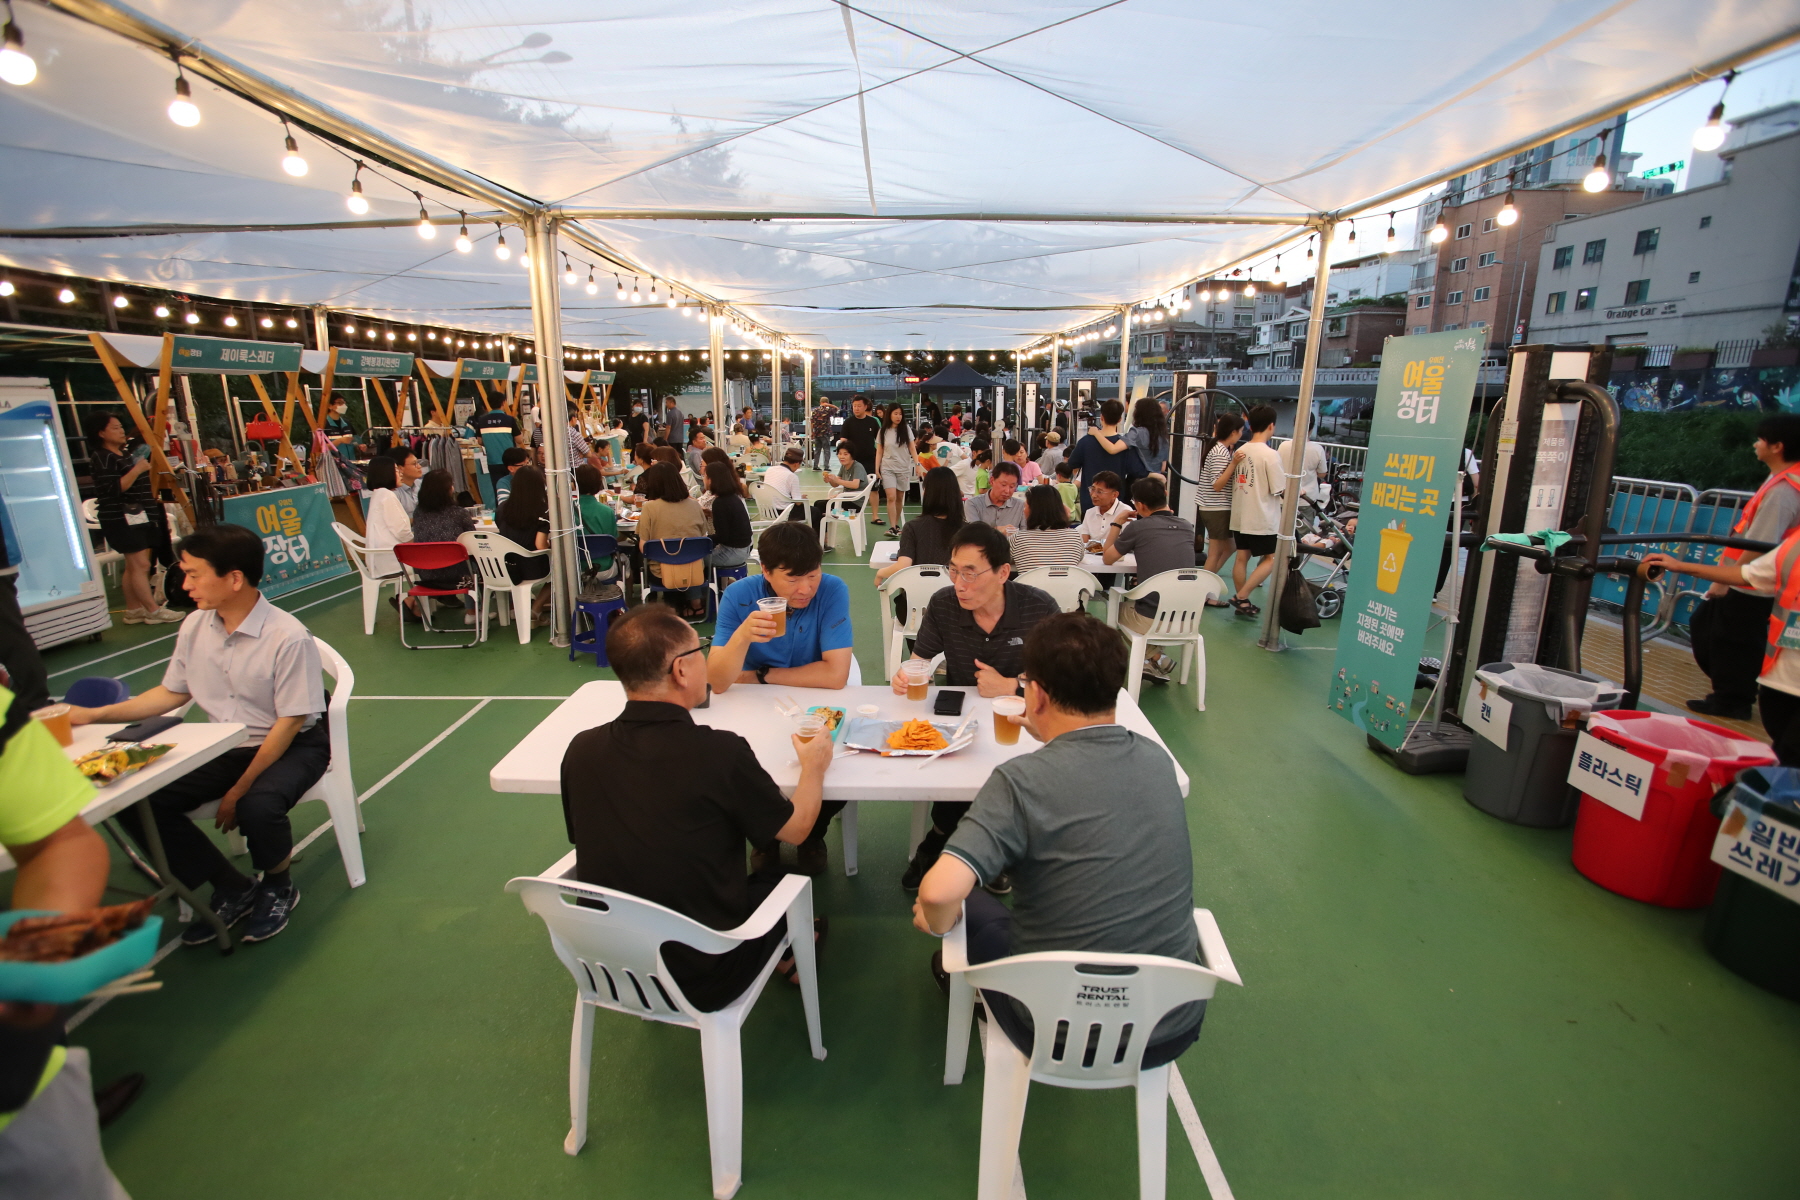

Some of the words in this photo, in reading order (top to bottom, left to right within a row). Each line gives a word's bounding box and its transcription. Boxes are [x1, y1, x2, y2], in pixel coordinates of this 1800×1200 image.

[1606, 309, 1638, 319] Orange
[220, 348, 274, 363] 제이룩스레더
[1402, 360, 1445, 395] 여울
[1397, 391, 1440, 424] 장터
[1543, 437, 1565, 447] 제품명
[1383, 453, 1436, 482] 쓰레기
[1536, 451, 1568, 463] 쭉쭉이
[1371, 482, 1417, 513] 버리는
[1418, 488, 1439, 516] 곳
[256, 504, 302, 537] 여울
[262, 534, 311, 565] 장터
[1367, 600, 1397, 623] 쓰레기는
[1357, 612, 1379, 632] 지정된
[1379, 621, 1404, 643] 곳에만
[1357, 629, 1395, 656] 버려주세요.
[1481, 703, 1491, 723] 캔
[1578, 751, 1643, 796] 플라스틱
[1077, 992, 1130, 1001] RENTAL
[1081, 984, 1129, 993] TRUST
